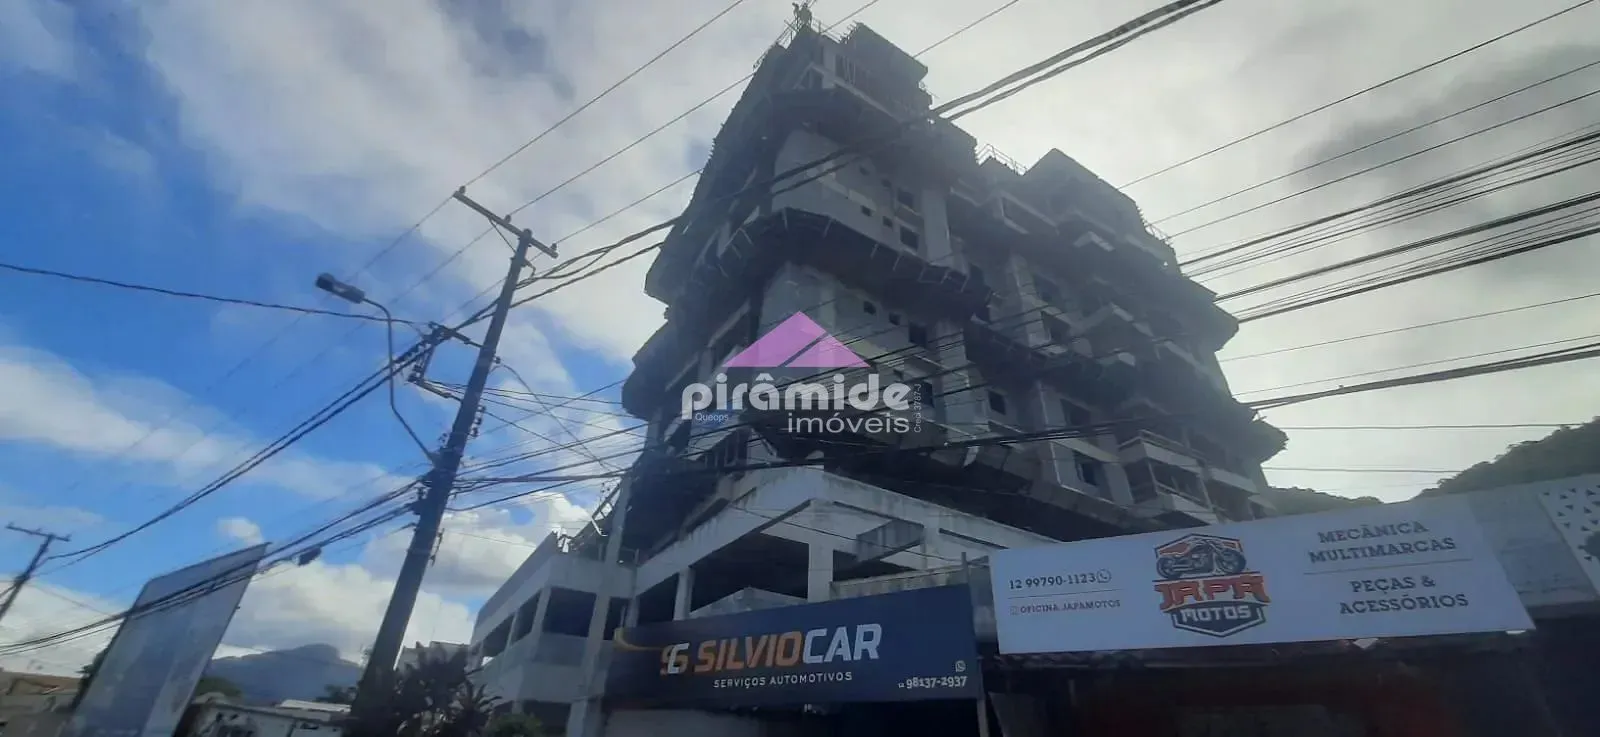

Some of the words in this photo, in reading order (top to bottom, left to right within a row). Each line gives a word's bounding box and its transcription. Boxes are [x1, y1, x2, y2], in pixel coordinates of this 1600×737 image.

[1318, 521, 1429, 543] MECÂNICA
[1308, 537, 1457, 563] MULTIMARCAS
[1009, 580, 1022, 589] 12
[1025, 573, 1096, 588] 99790-1123
[1350, 576, 1415, 594] PEÇAS
[1421, 575, 1436, 588] &
[1154, 574, 1271, 611] JAPA
[1181, 604, 1251, 622] MOTOS
[1340, 594, 1469, 614] ACESSÓRIOS
[695, 623, 882, 673] SILVIOCAR
[713, 676, 766, 689] SERVIÇOS
[769, 671, 853, 685] AUTOMOTIVOS
[906, 676, 968, 689] 98137-2937
